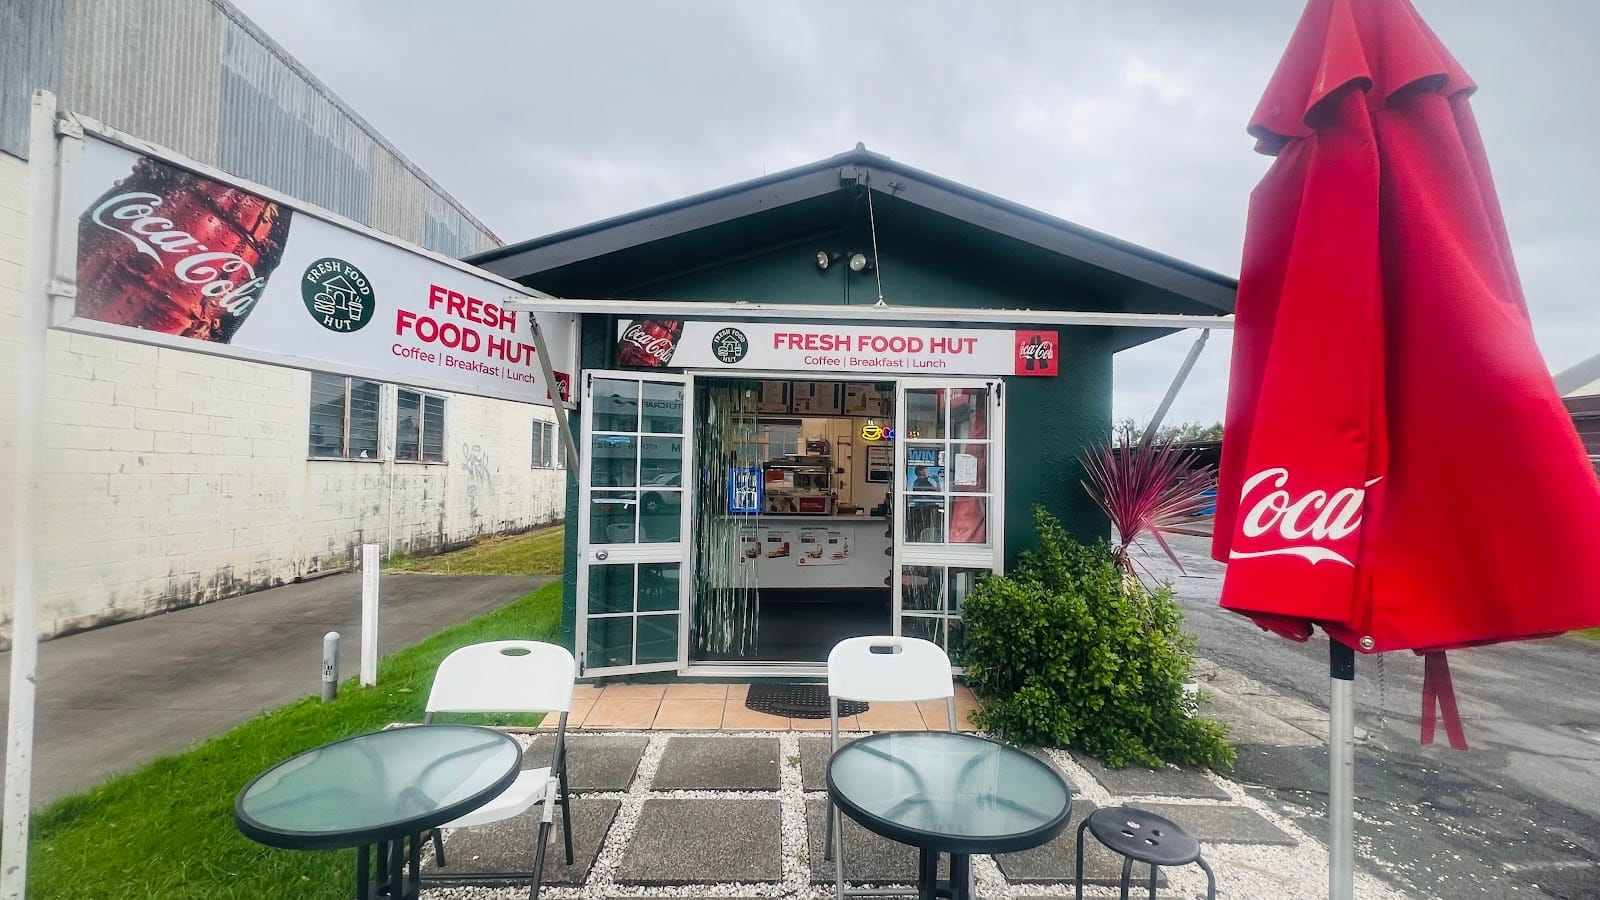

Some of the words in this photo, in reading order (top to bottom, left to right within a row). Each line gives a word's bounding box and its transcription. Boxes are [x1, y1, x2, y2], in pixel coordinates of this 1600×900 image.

[92, 192, 265, 316] Coca-Cola
[307, 261, 341, 284] FRESH
[344, 265, 370, 295] FOOD
[323, 314, 352, 330] HUT
[428, 284, 517, 333] FRESH
[396, 309, 481, 353] FOOD
[487, 334, 536, 366] HUT
[622, 324, 676, 362] Coca-Cola
[714, 329, 731, 343] FRESH
[731, 329, 746, 343] FOOD
[773, 333, 851, 351] FRESH
[858, 335, 923, 354] FOOD
[930, 337, 978, 355] HUT
[392, 343, 435, 363] Coffee
[445, 355, 500, 377] Breakfast
[506, 368, 535, 384] Lunch
[804, 355, 841, 367] Coffee
[849, 357, 904, 368] Breakfast
[912, 359, 946, 369] Lunch
[908, 449, 935, 460] WIN
